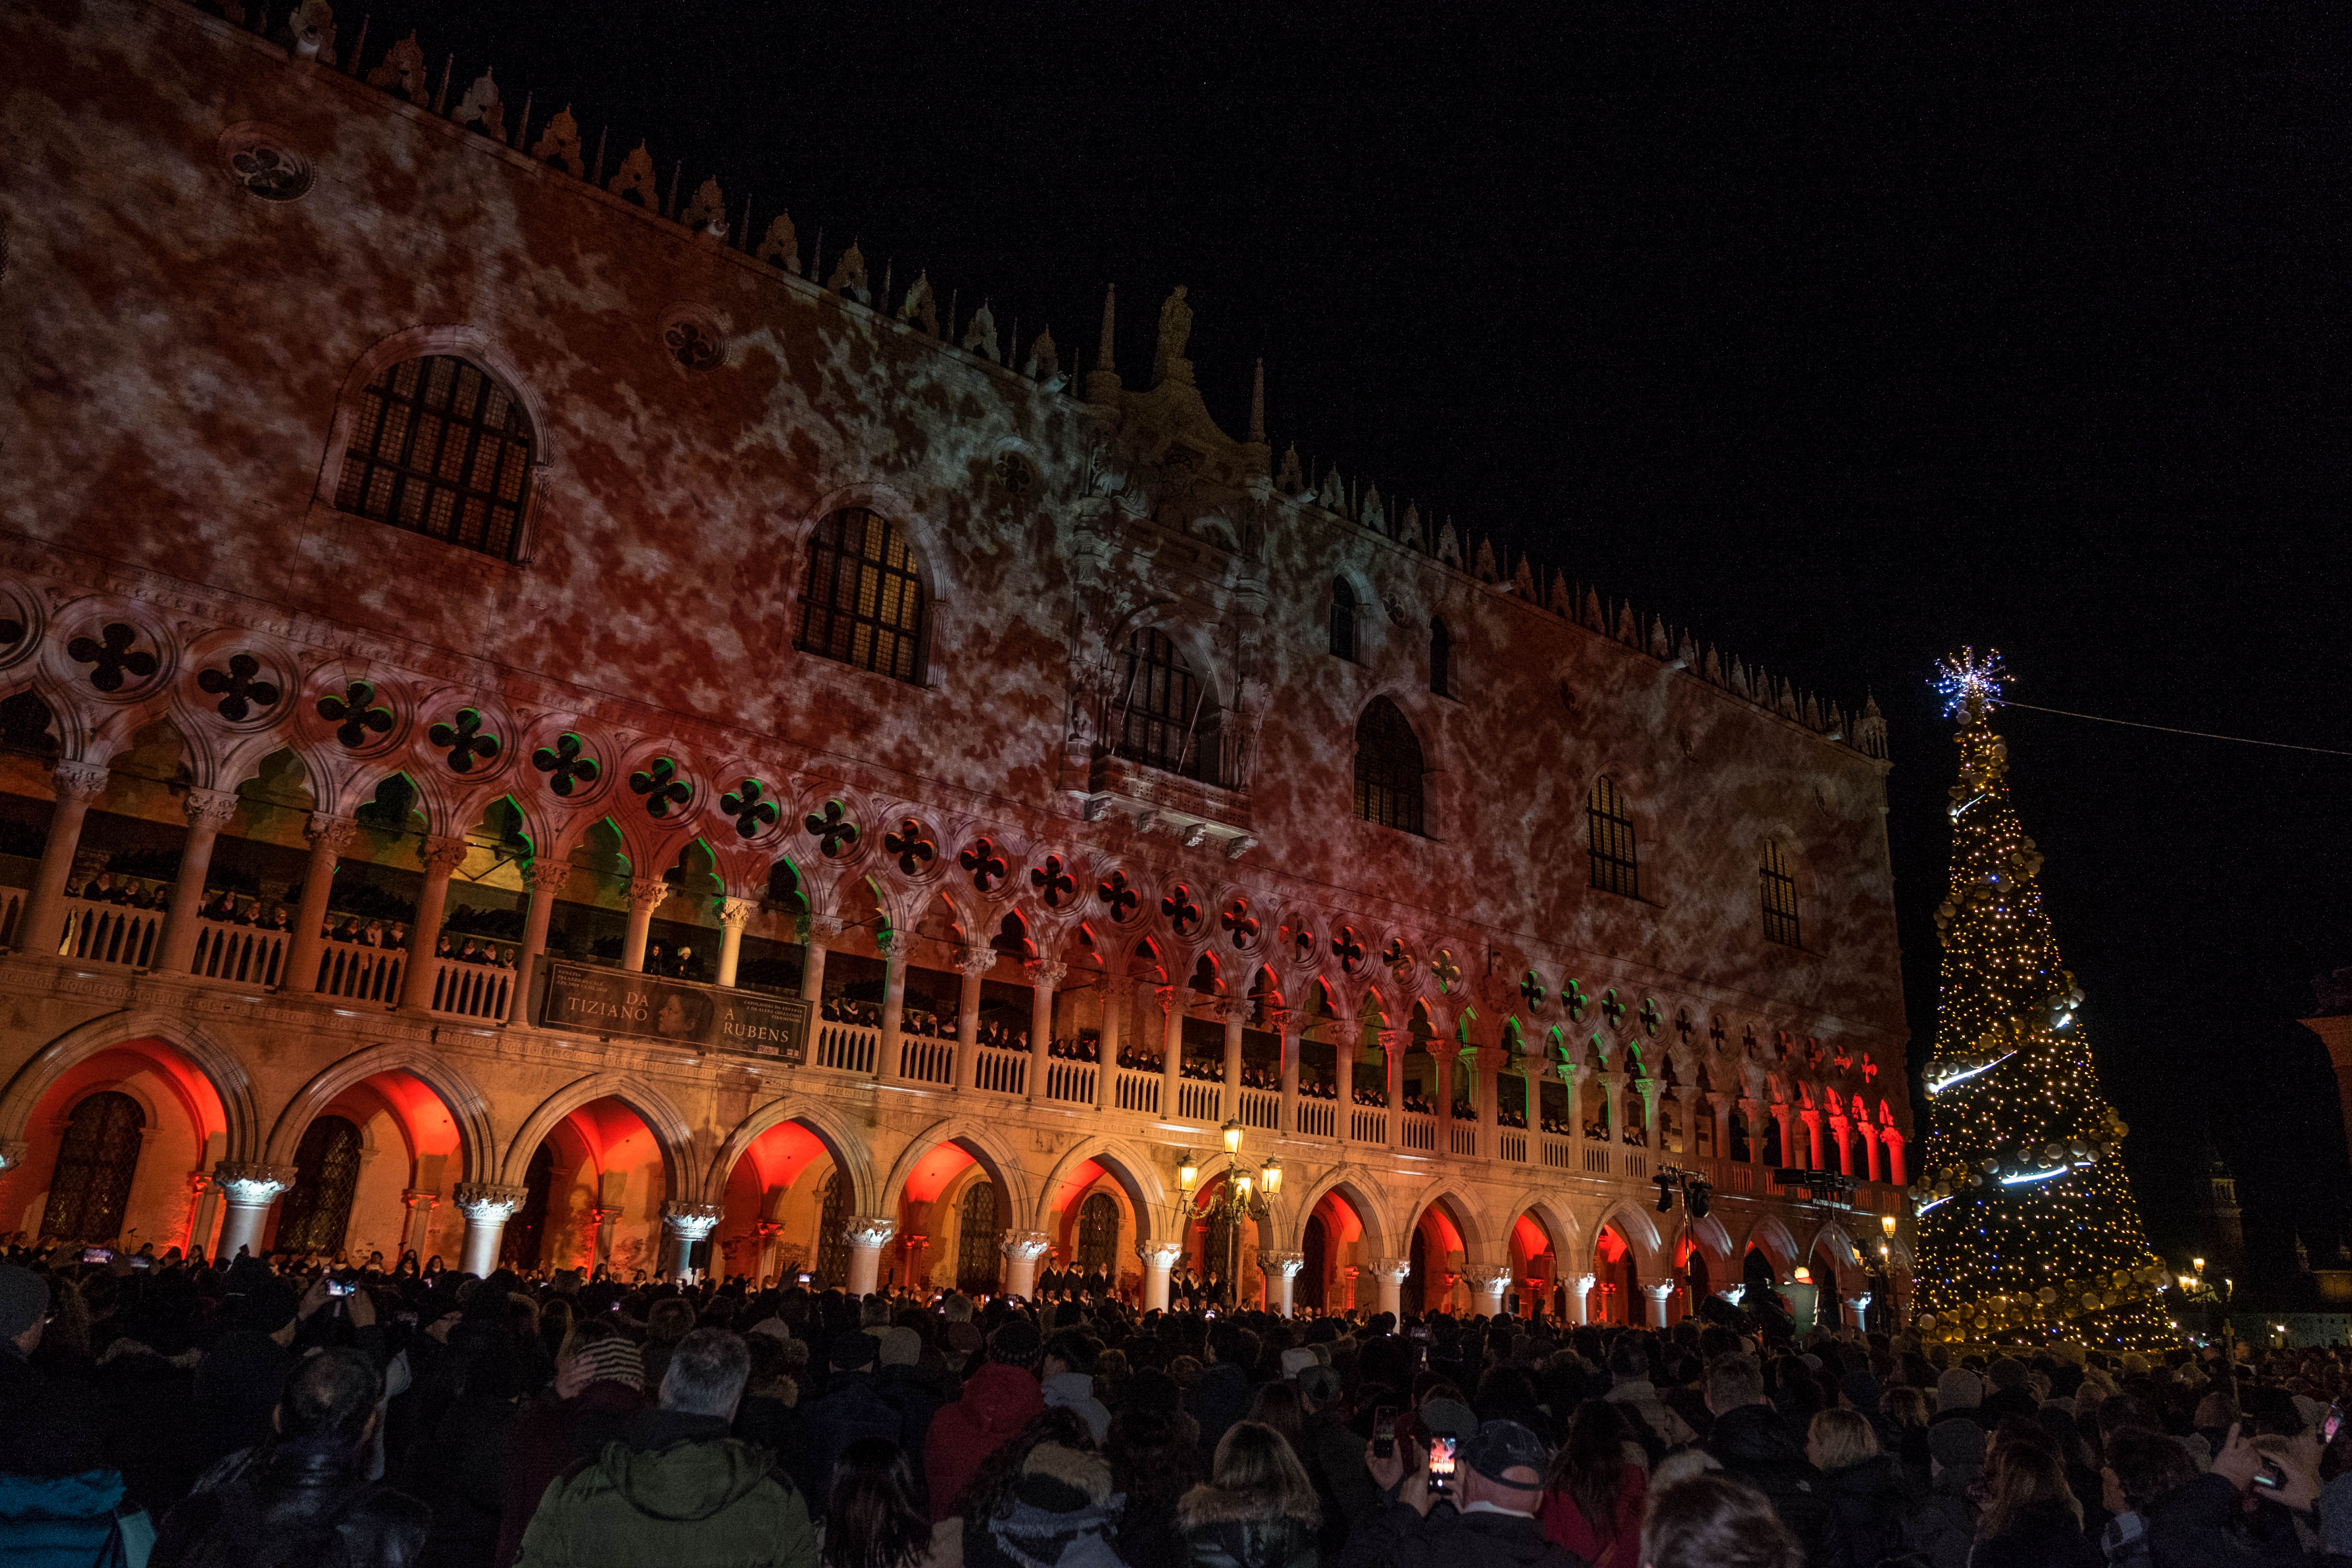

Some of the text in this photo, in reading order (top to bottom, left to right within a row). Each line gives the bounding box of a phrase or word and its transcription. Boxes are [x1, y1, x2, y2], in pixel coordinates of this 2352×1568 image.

[557, 975, 581, 983] PALAZZO
[626, 992, 649, 1007] DA
[744, 1000, 773, 1009] CAPOLAVORI
[568, 997, 648, 1021] TIZIANO
[724, 1008, 735, 1020] A
[772, 1015, 800, 1023] FIAMMINGHI
[723, 1022, 789, 1042] RUBENS
